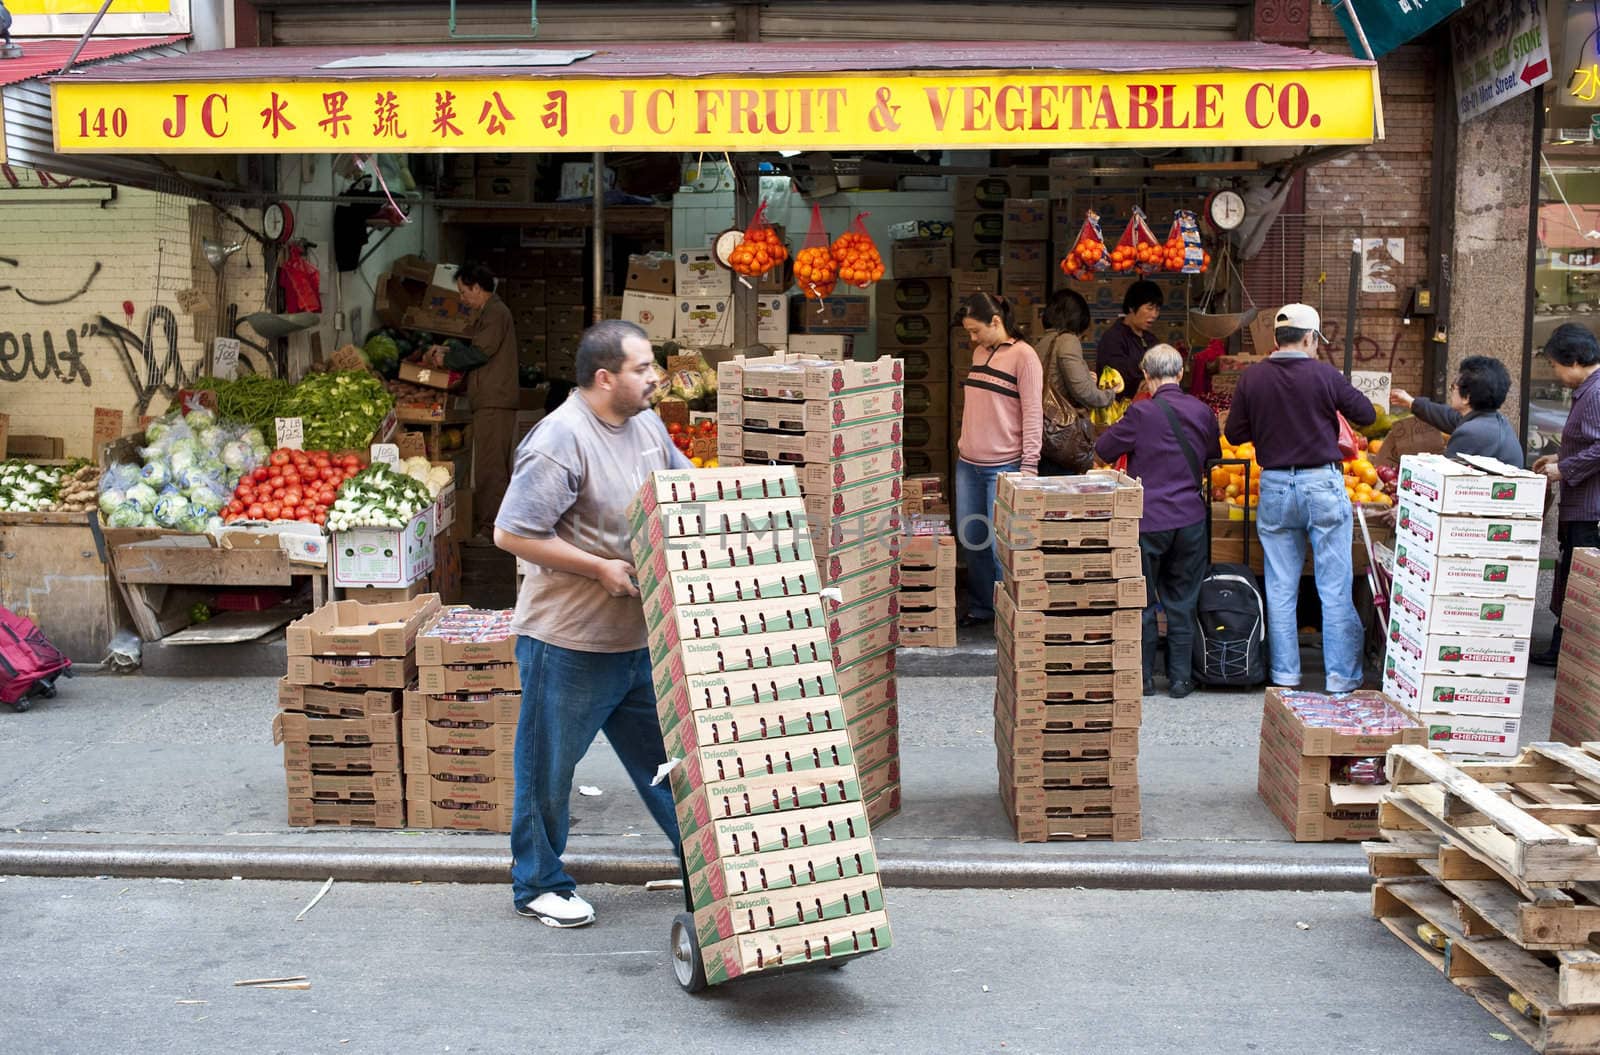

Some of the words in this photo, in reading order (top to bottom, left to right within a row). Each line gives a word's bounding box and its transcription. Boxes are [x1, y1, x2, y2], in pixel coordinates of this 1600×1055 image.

[1512, 27, 1542, 60] STONE
[78, 107, 128, 138] 140
[162, 93, 229, 139] JC
[259, 89, 568, 139] 水果蔬菜公司
[610, 89, 675, 135] JC
[694, 88, 847, 135] FRUIT
[868, 86, 901, 132] &
[923, 83, 1224, 132] VEGETABLE
[1244, 82, 1322, 129] CO.
[1462, 654, 1511, 663] CHERRIES
[1457, 695, 1506, 704] CHERRIES
[1452, 733, 1501, 743] CHERRIES
